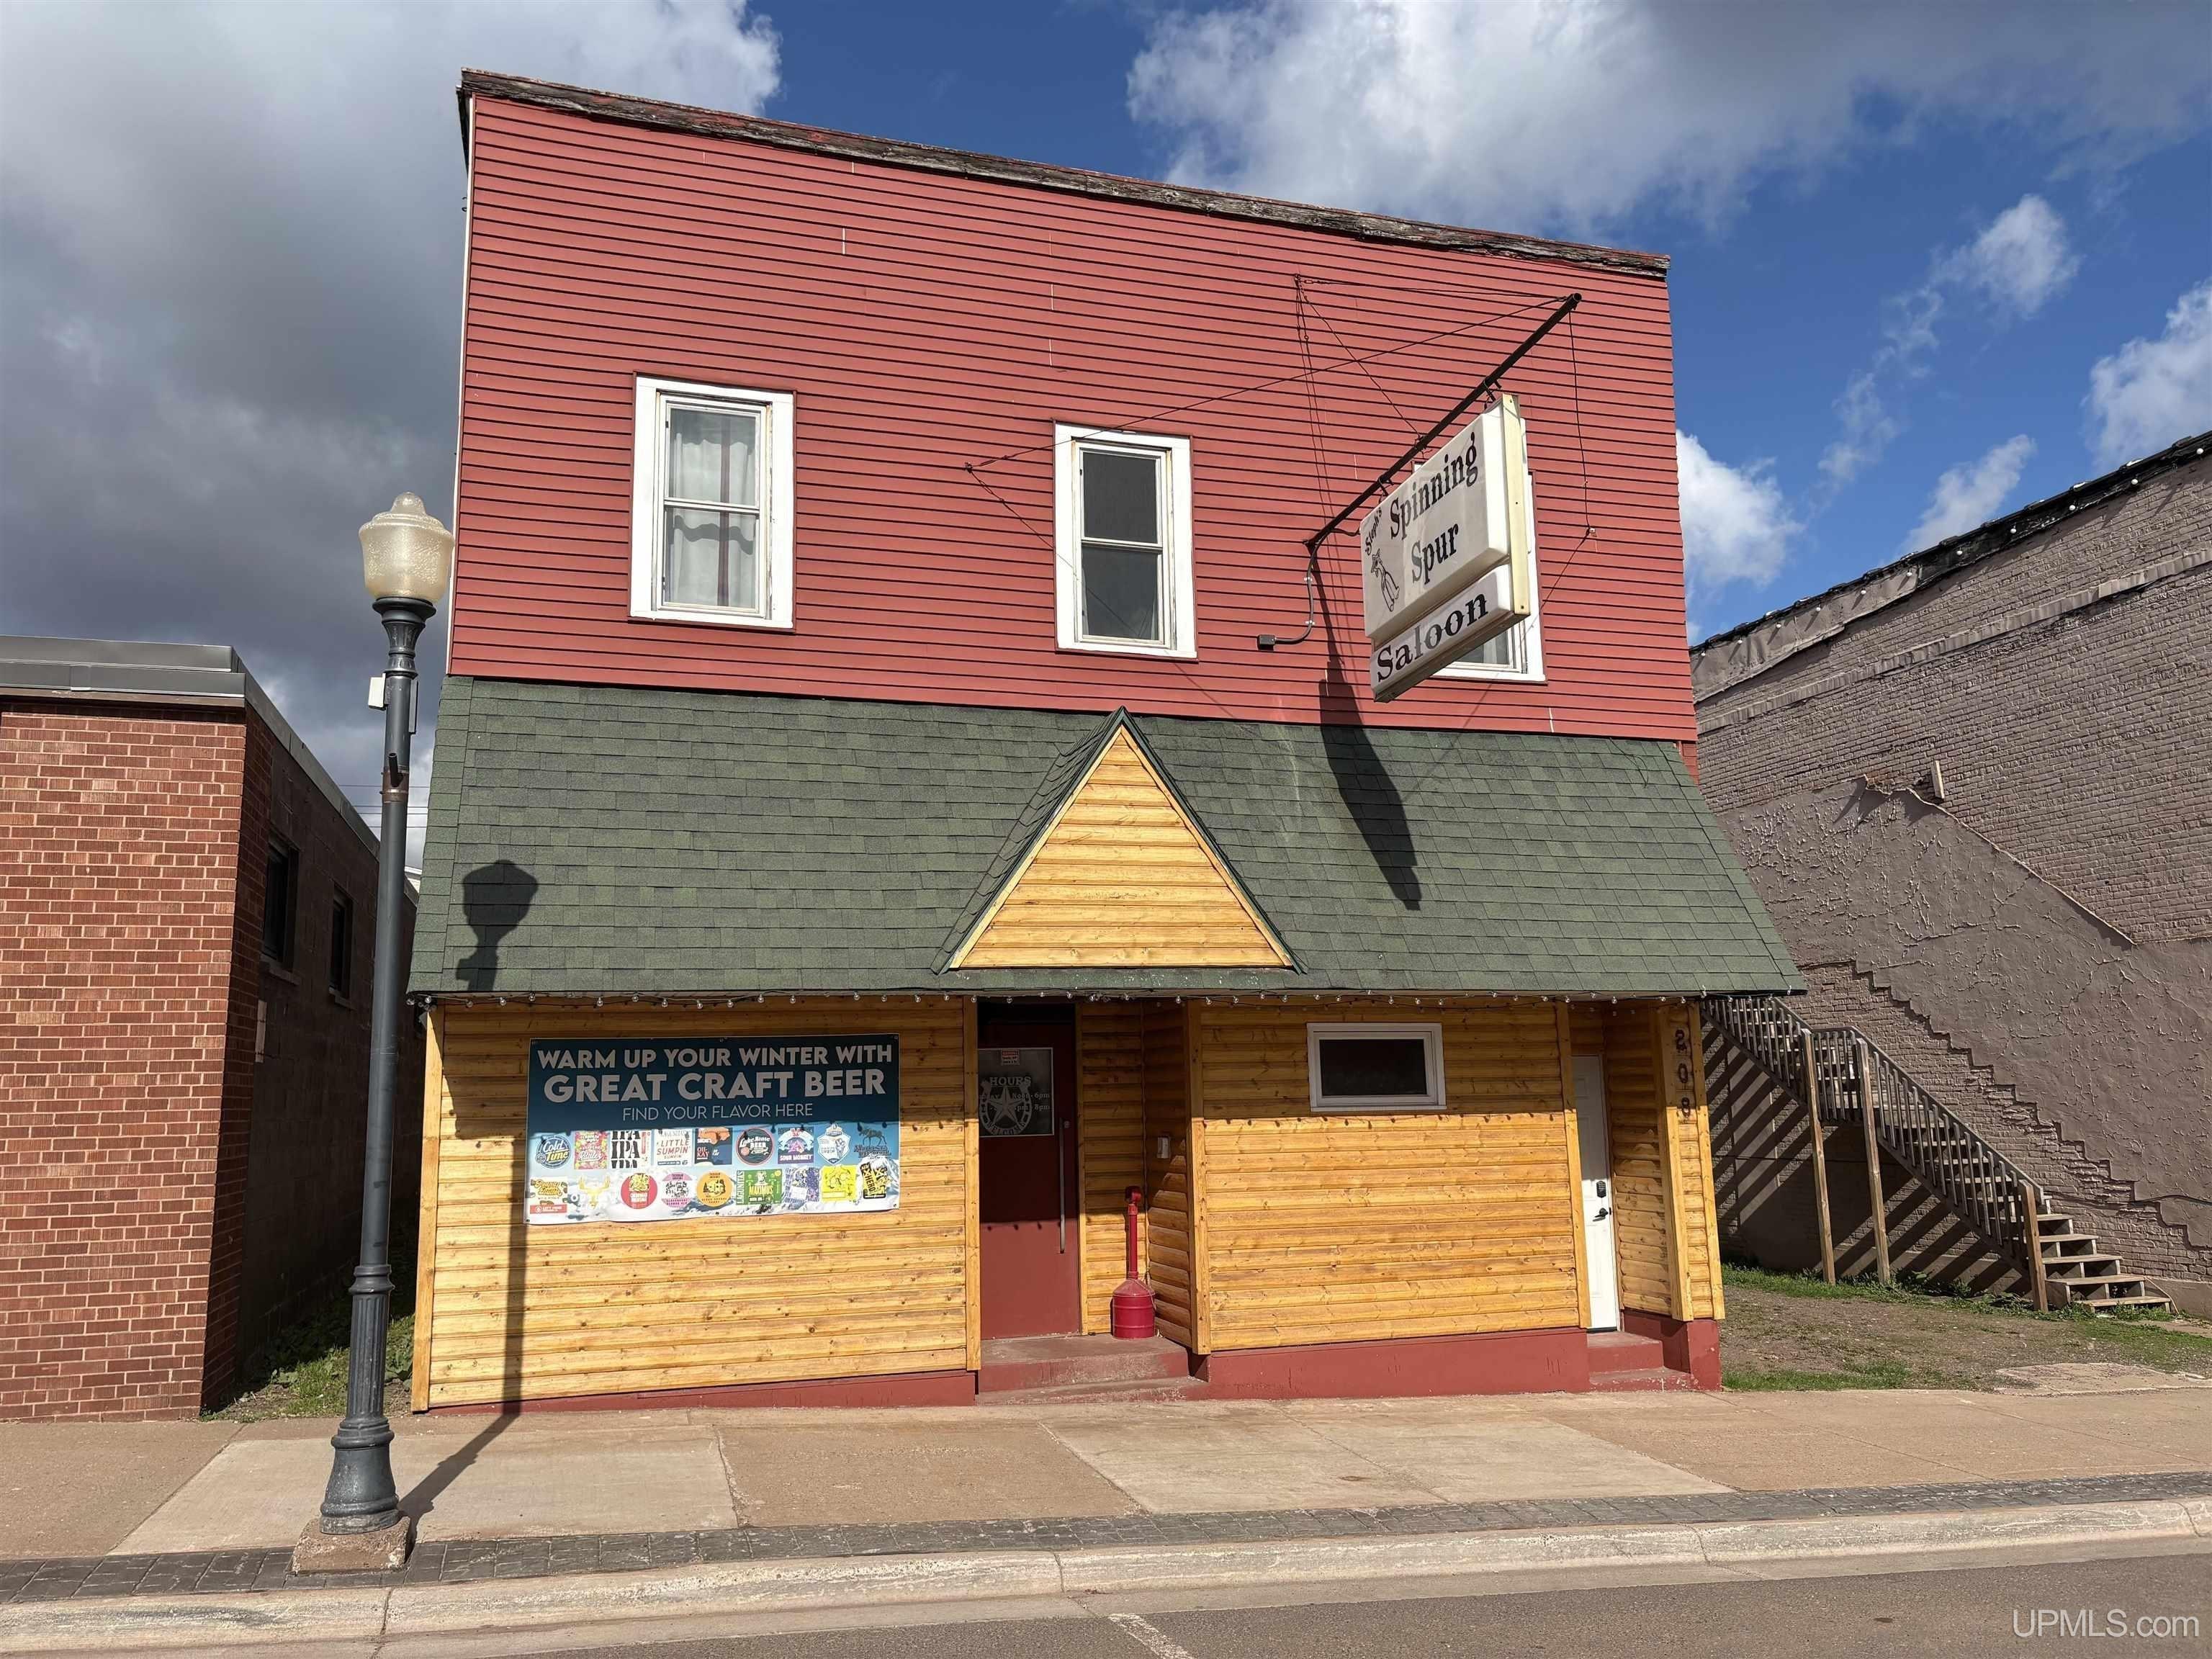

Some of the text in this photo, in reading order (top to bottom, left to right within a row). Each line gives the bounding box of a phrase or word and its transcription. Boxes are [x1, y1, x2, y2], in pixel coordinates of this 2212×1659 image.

[1390, 431, 1478, 540] Spinning
[1365, 507, 1382, 556] Steph's
[1411, 523, 1459, 585] Spur
[1377, 593, 1488, 683] Saloon
[537, 1044, 892, 1069] WARM UP YOUR WINTER WITH
[544, 1069, 886, 1103] GREAT CRAFT BEER
[989, 1076, 1031, 1087] HOURS
[622, 1103, 813, 1121] FIND YOUR FLAVOR HERE
[543, 1140, 565, 1152] Cold
[547, 1151, 568, 1161] Time
[611, 1141, 639, 1159] IPA
[749, 1185, 773, 1195] MAXIMUS
